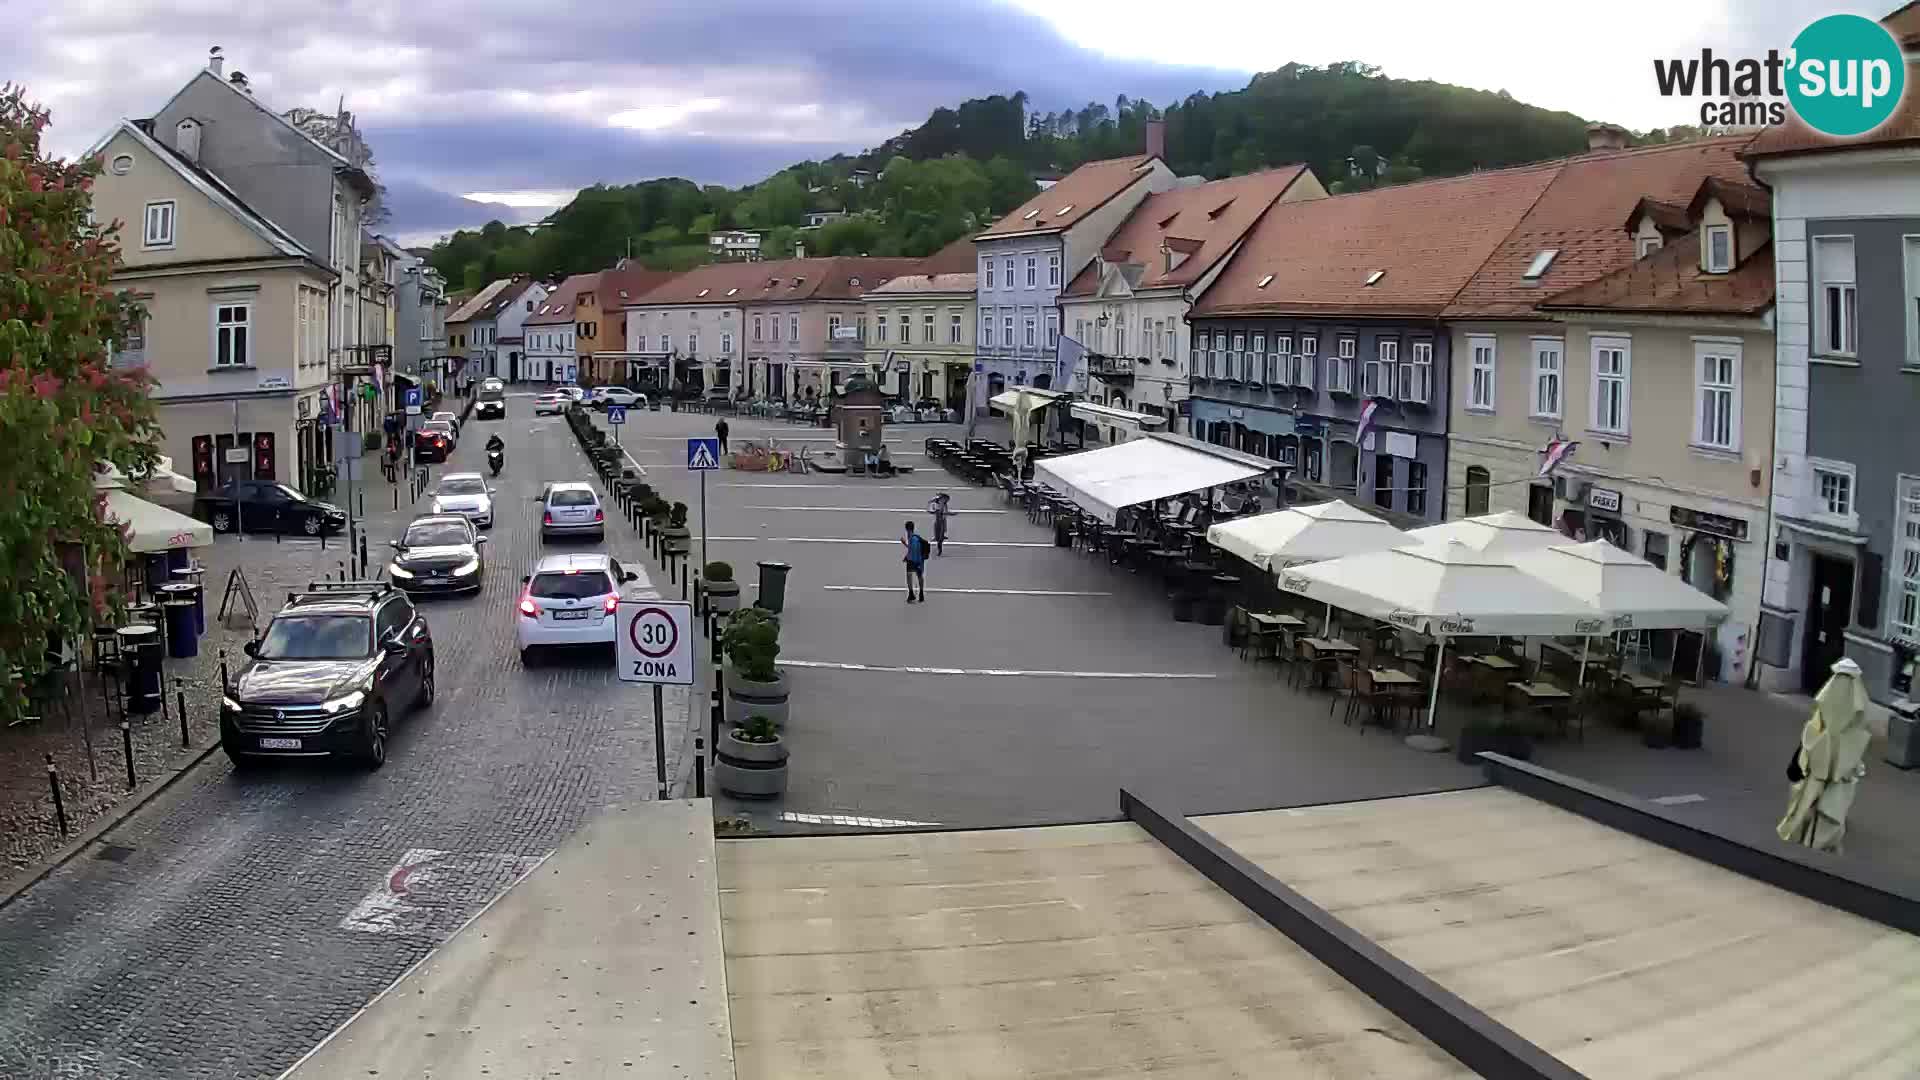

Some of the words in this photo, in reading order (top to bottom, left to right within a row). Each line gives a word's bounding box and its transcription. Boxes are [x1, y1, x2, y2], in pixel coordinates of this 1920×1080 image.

[409, 392, 417, 404] P
[642, 623, 667, 645] 30
[633, 660, 677, 677] ZONA
